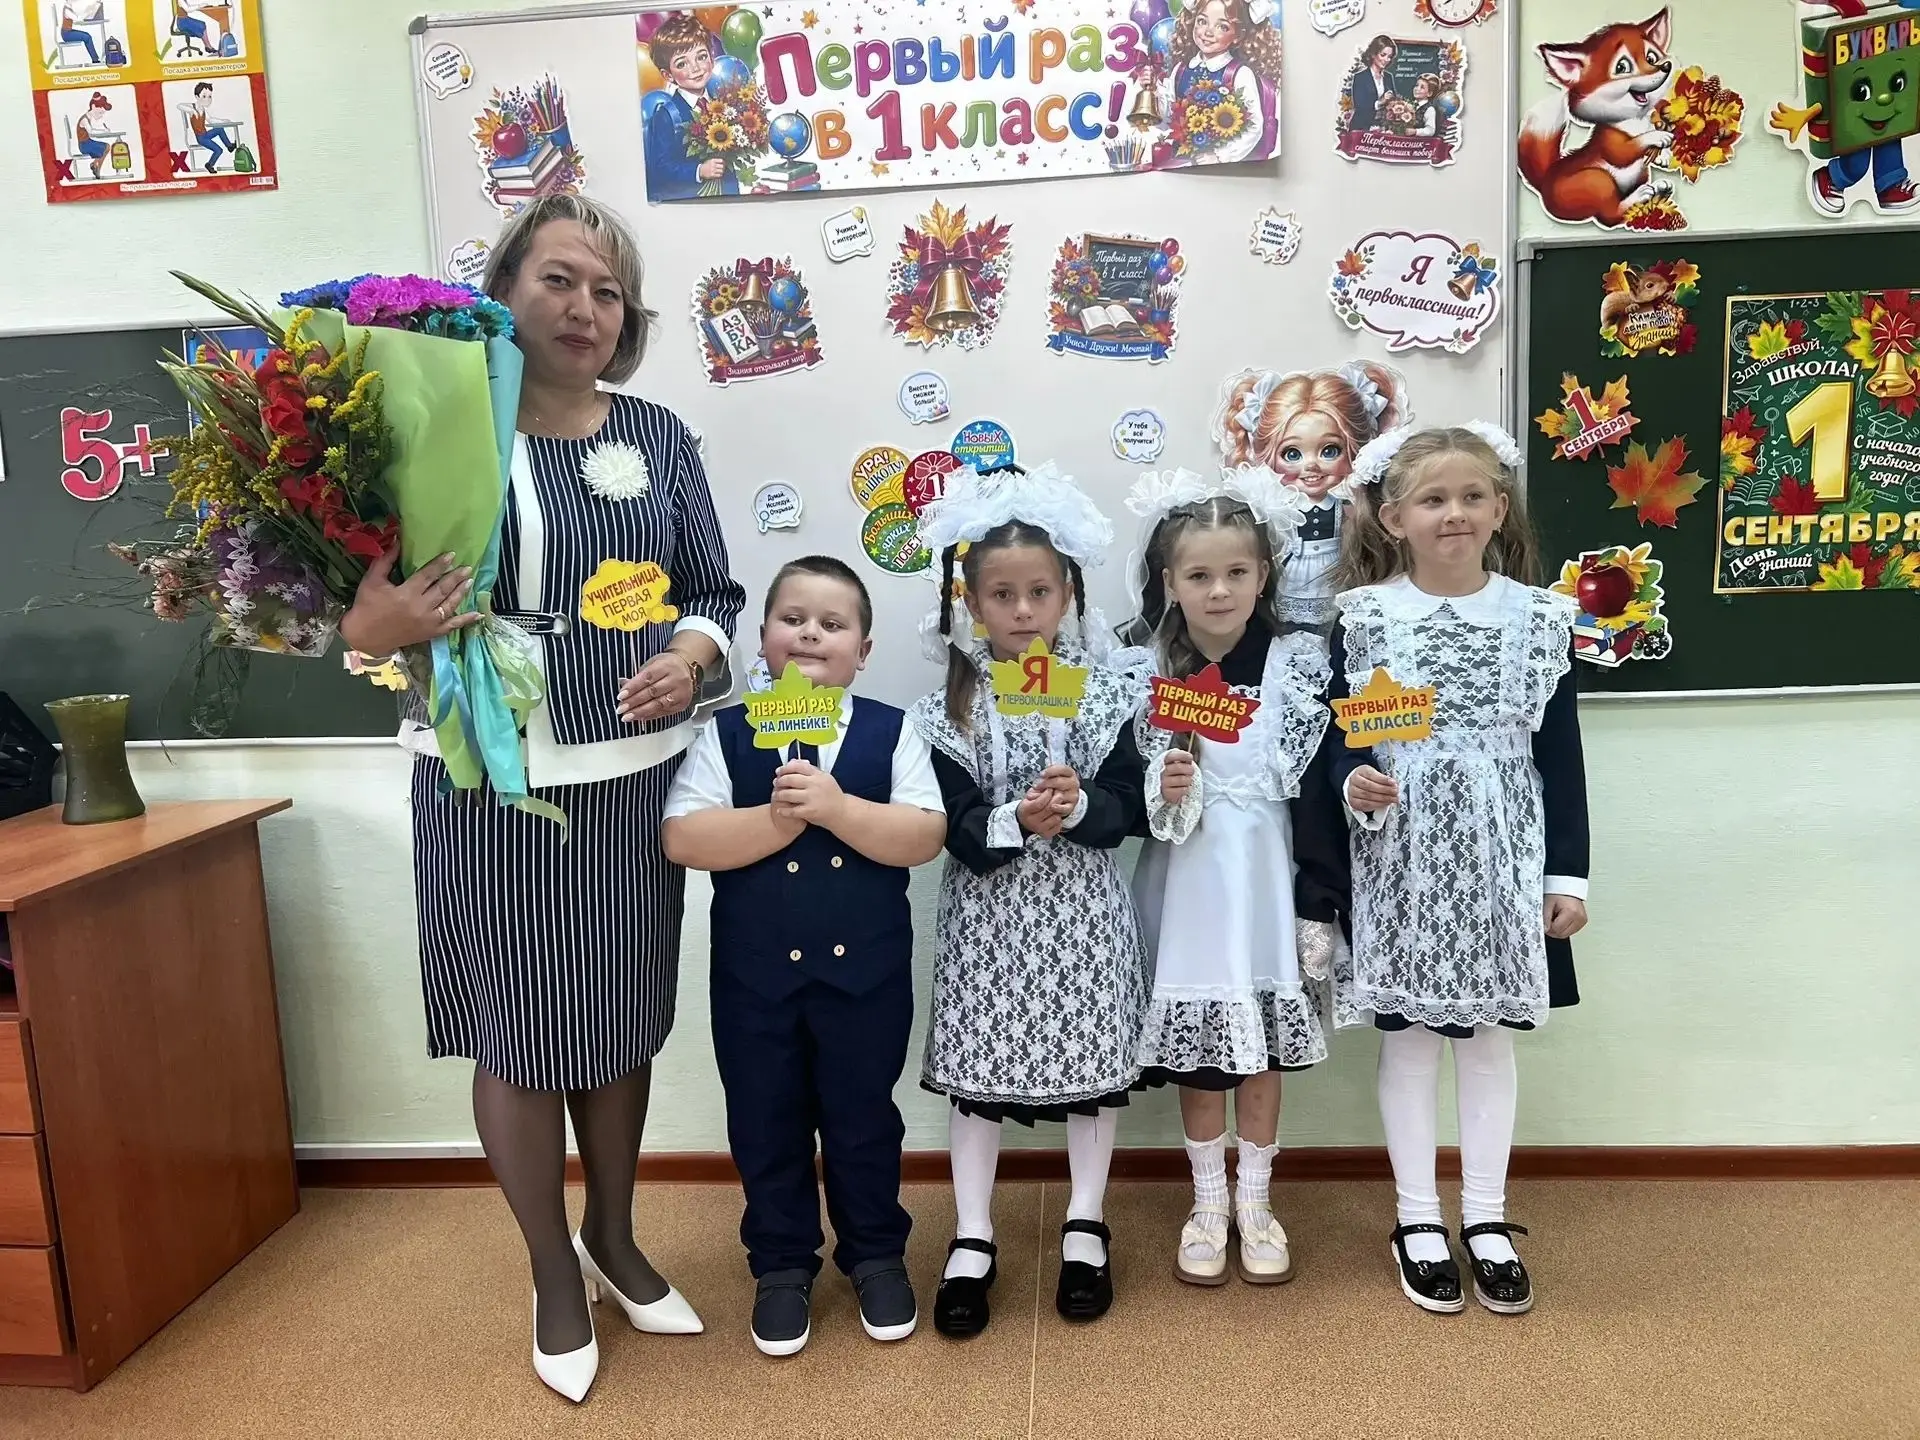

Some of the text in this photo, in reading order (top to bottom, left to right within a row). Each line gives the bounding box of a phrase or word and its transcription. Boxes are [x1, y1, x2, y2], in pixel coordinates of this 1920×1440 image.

[1836, 18, 1920, 65] БУКВАРЬ
[760, 14, 1141, 105] Первый раз
[811, 81, 1127, 162] в 1 класс!
[456, 257, 473, 267] Пусть
[1096, 250, 1142, 266] Первый раз
[1401, 255, 1434, 285] Я
[1102, 267, 1147, 279] в 1 класс!
[1355, 287, 1486, 321] первоклассница!
[722, 315, 742, 331] АЗ
[726, 325, 747, 342] БУ
[732, 337, 757, 355] КА
[1064, 335, 1153, 354] Учись! Дружи! Мечтай!
[727, 352, 806, 376] Знания открывают мир!
[1731, 337, 1825, 385] Здравствуй,
[1766, 360, 1859, 387] ШКОЛА!
[908, 384, 928, 393] Вместе
[913, 390, 935, 399] сможем
[1565, 388, 1602, 434] 1
[1134, 422, 1148, 430] тебя
[1564, 417, 1627, 454] СЕНТЯБРЯ
[62, 408, 169, 500] 5+
[954, 442, 1010, 456] открытий!
[1785, 381, 1855, 502] 1
[1854, 434, 1920, 457] С начало
[854, 450, 891, 481] УРА!
[1859, 454, 1920, 473] учебного
[860, 460, 905, 501] В ШКОЛУ!
[1869, 471, 1908, 488] года!
[864, 510, 914, 545] Больших
[1723, 511, 1920, 546] СЕНТЯБРЯ
[1728, 548, 1778, 578] День
[1758, 554, 1813, 580] знаний
[586, 566, 661, 606] УЧИТЕЛЬНИЦА
[602, 588, 652, 618] ПЕРВАЯ
[621, 606, 647, 626] МОЯ
[1020, 655, 1049, 694] Я
[752, 696, 835, 717] ПЕРВЫЙ РАЗ
[1003, 694, 1073, 707] ПЕРВОКЛАШКА!
[1157, 683, 1248, 716] ПЕРВЫЙ РАЗ
[1341, 694, 1428, 718] ПЕРВЫЙ РАЗ
[760, 716, 830, 733] НА ЛИНЕЙКЕ!
[1158, 701, 1237, 731] В ШКОЛЕ!
[1351, 712, 1422, 734] В КЛАССЕ!
